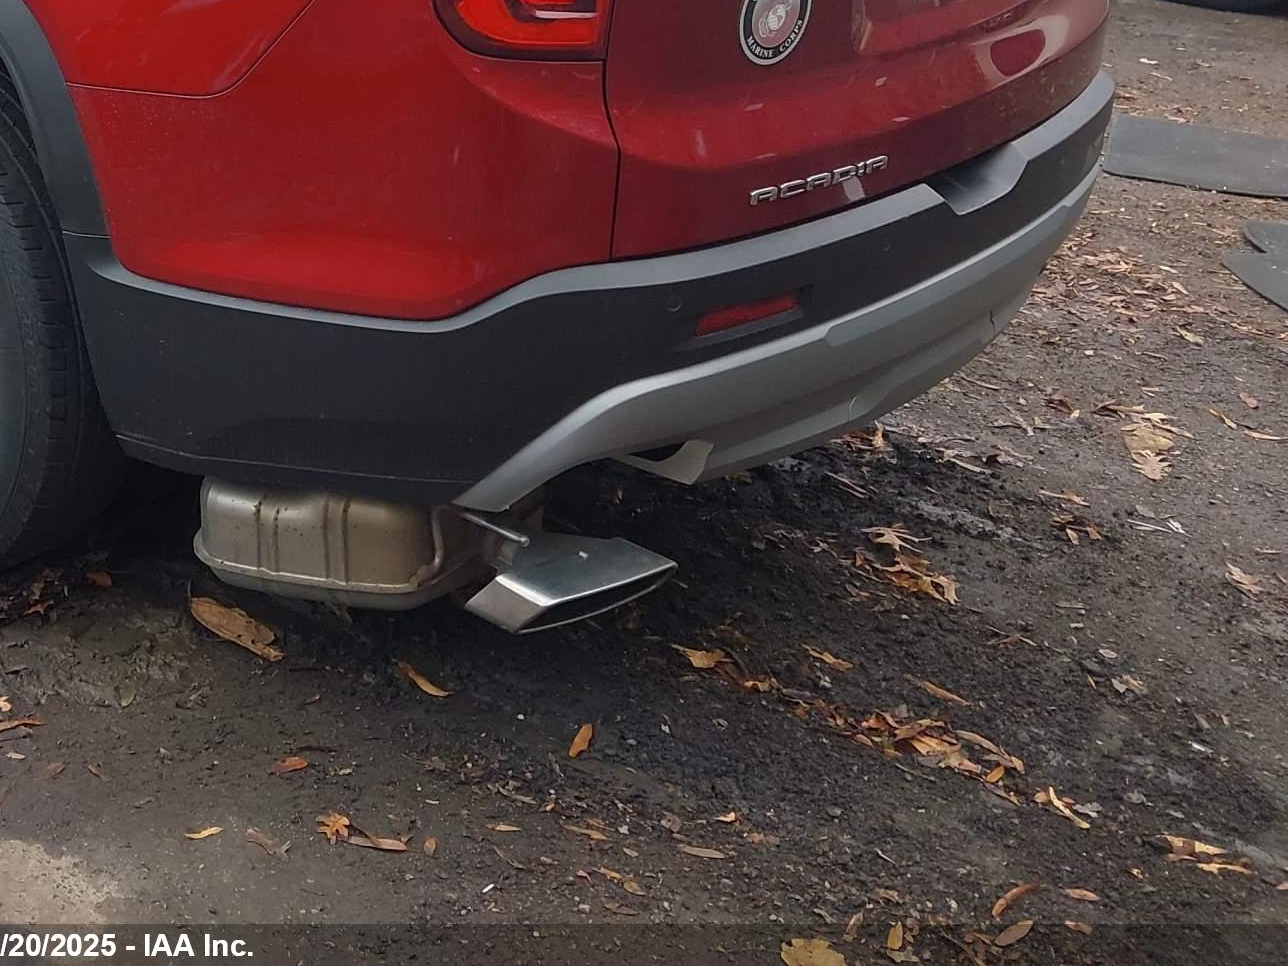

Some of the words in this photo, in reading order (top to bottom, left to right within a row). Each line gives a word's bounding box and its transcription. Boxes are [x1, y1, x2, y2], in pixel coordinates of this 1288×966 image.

[746, 34, 774, 58] MARINE
[779, 19, 803, 52] CORPS
[750, 155, 889, 206] ACADIA
